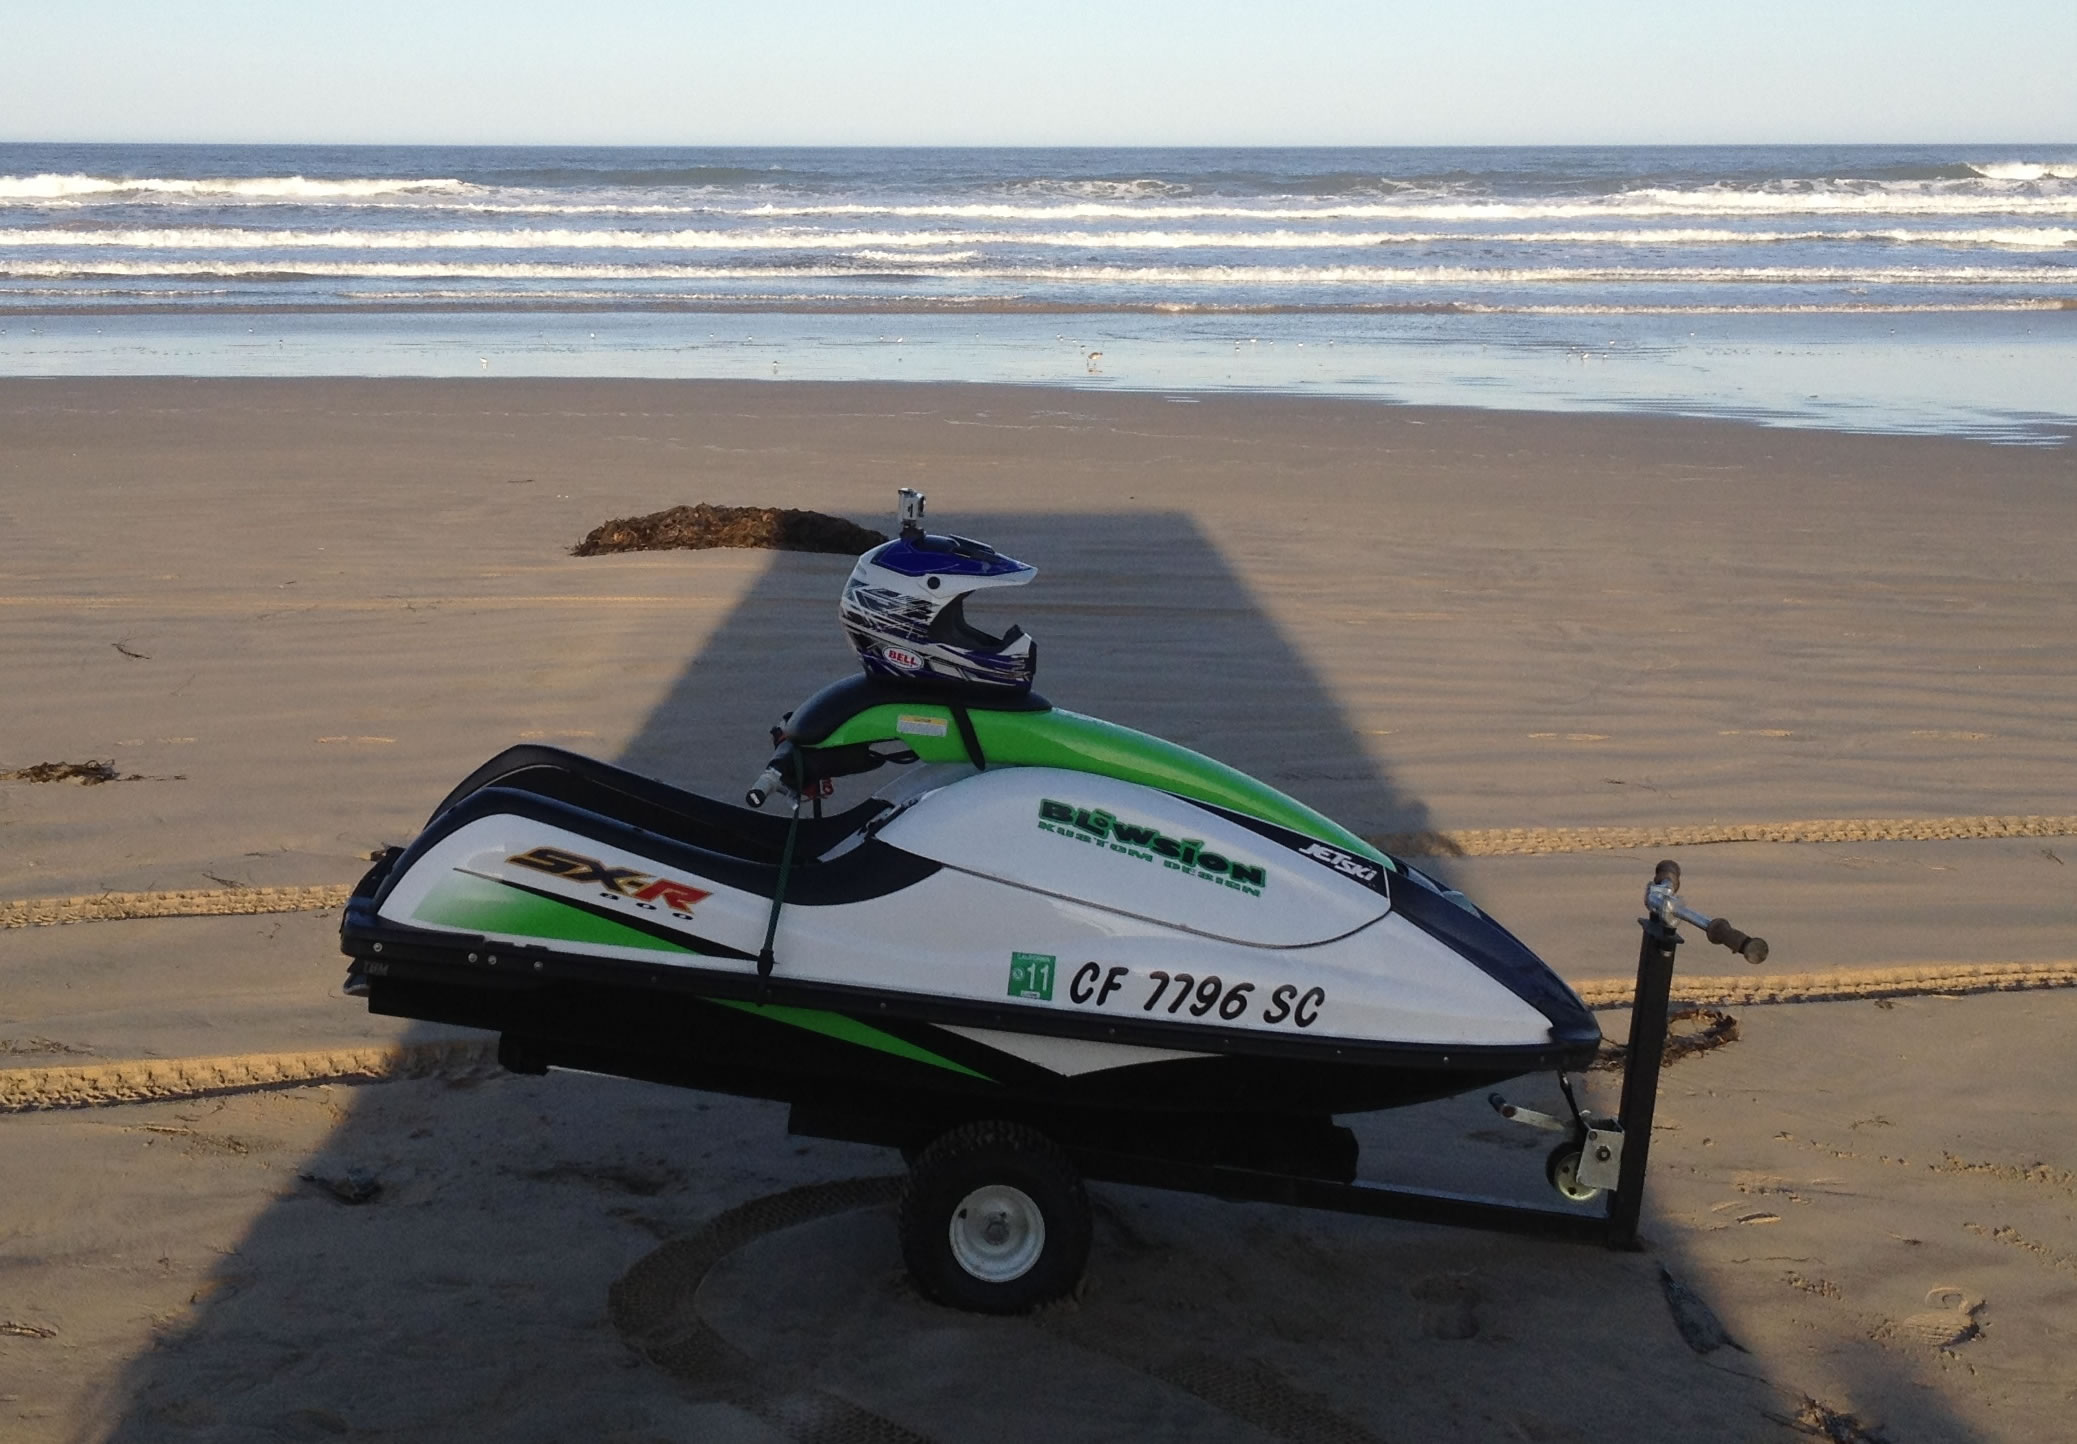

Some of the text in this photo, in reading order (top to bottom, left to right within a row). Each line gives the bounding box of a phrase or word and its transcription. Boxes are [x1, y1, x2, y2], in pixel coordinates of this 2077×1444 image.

[889, 650, 917, 665] BELL
[505, 847, 714, 914] SX-R
[1037, 820, 1261, 898] KUSTOM DESIGN
[1027, 963, 1049, 991] 11
[1069, 961, 1326, 1028] CF 7796 SC
